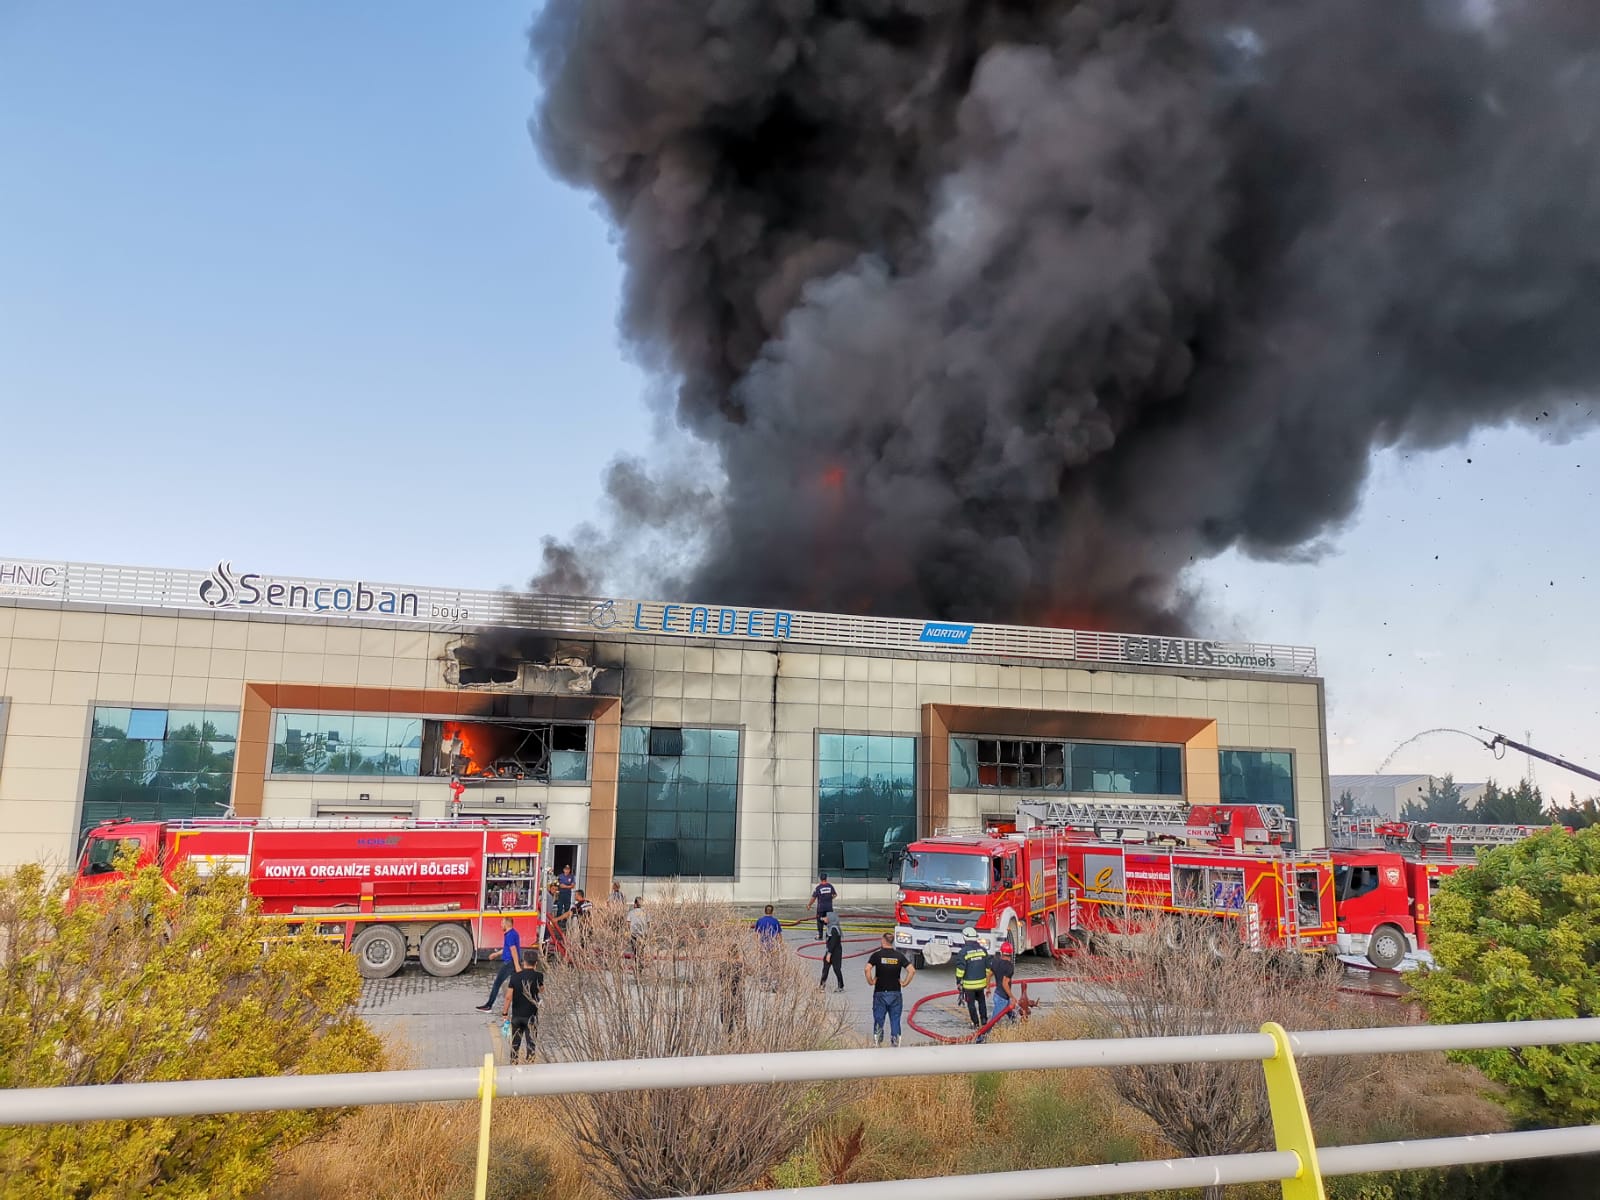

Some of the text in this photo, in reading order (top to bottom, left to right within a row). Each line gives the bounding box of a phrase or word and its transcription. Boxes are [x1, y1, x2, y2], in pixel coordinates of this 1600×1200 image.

[239, 574, 469, 622] Sençoban boya
[633, 602, 793, 640] LEADER
[926, 628, 968, 639] NORTON
[1123, 636, 1276, 668] GRAUS polymers
[265, 860, 469, 877] KONYA ORGANİZE SANAYİ BÖLGESİ
